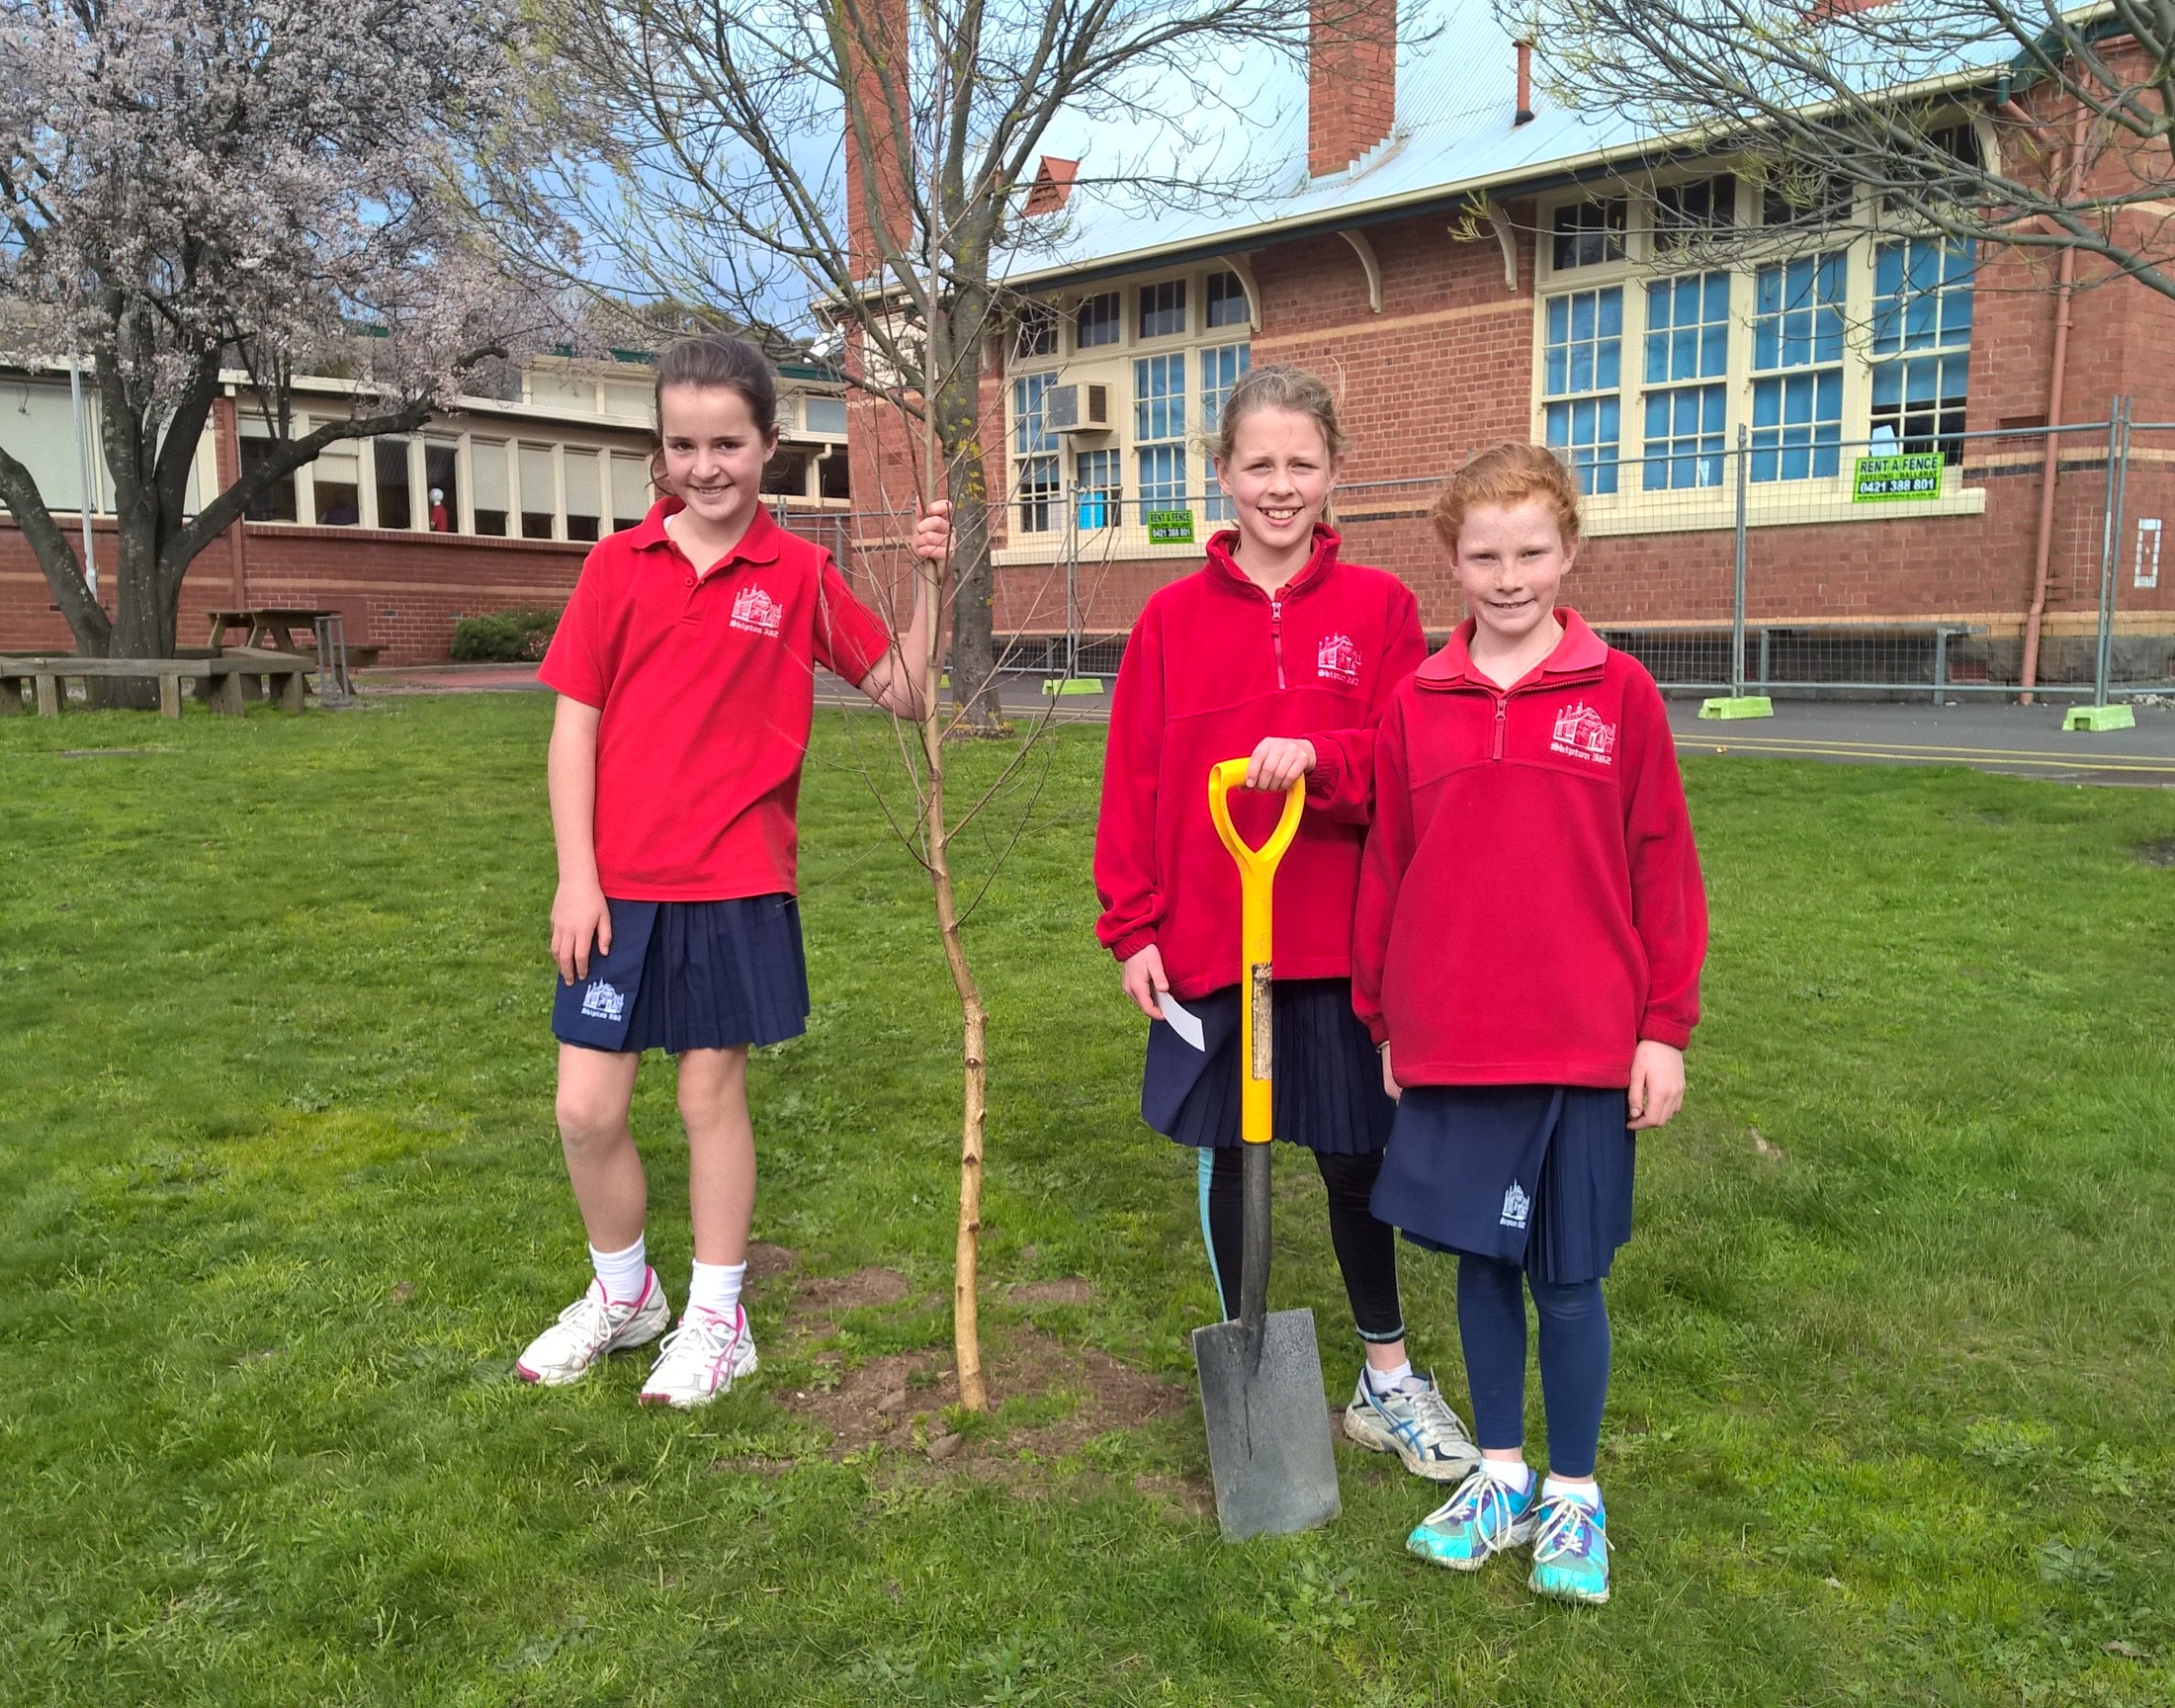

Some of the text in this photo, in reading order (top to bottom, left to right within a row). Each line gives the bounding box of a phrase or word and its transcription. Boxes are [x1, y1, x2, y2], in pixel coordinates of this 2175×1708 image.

[1860, 457, 1938, 473] RENT A FENCE
[1860, 477, 1935, 494] 0421 388 801
[1151, 513, 1165, 522] RENT
[1172, 512, 1190, 522] FENCE
[1550, 741, 1591, 760] Skipton
